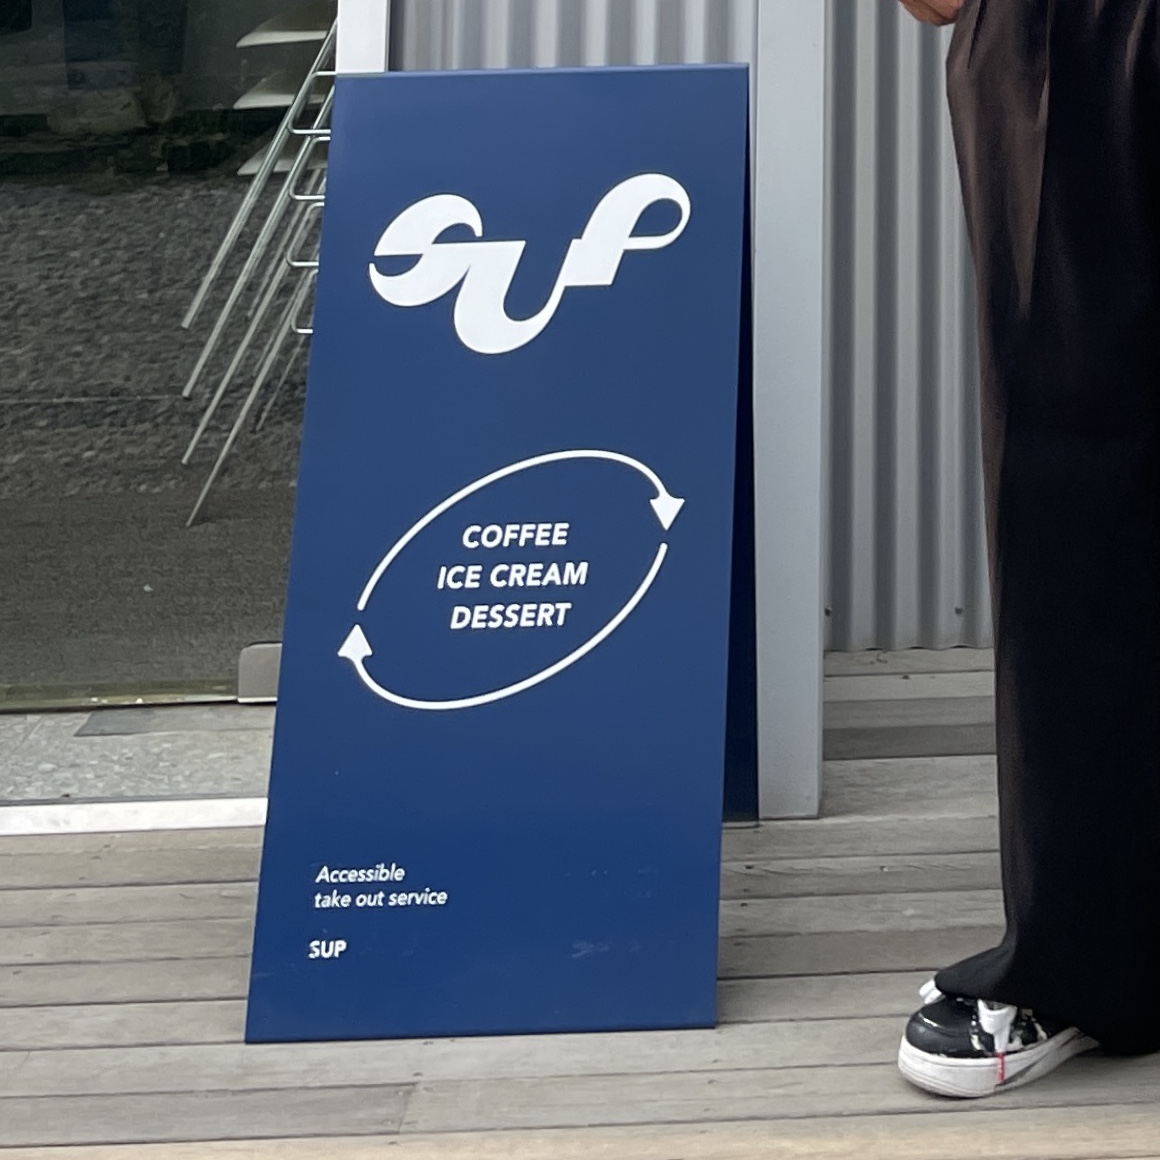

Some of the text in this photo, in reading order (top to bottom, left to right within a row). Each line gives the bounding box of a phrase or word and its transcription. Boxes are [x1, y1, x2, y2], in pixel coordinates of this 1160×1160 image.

[462, 522, 570, 549] COFFEE
[437, 561, 589, 590] ICE CREAM
[450, 602, 572, 630] DESSERT
[315, 862, 406, 883] Accessible
[314, 887, 448, 908] take out service
[308, 939, 347, 959] SUP
